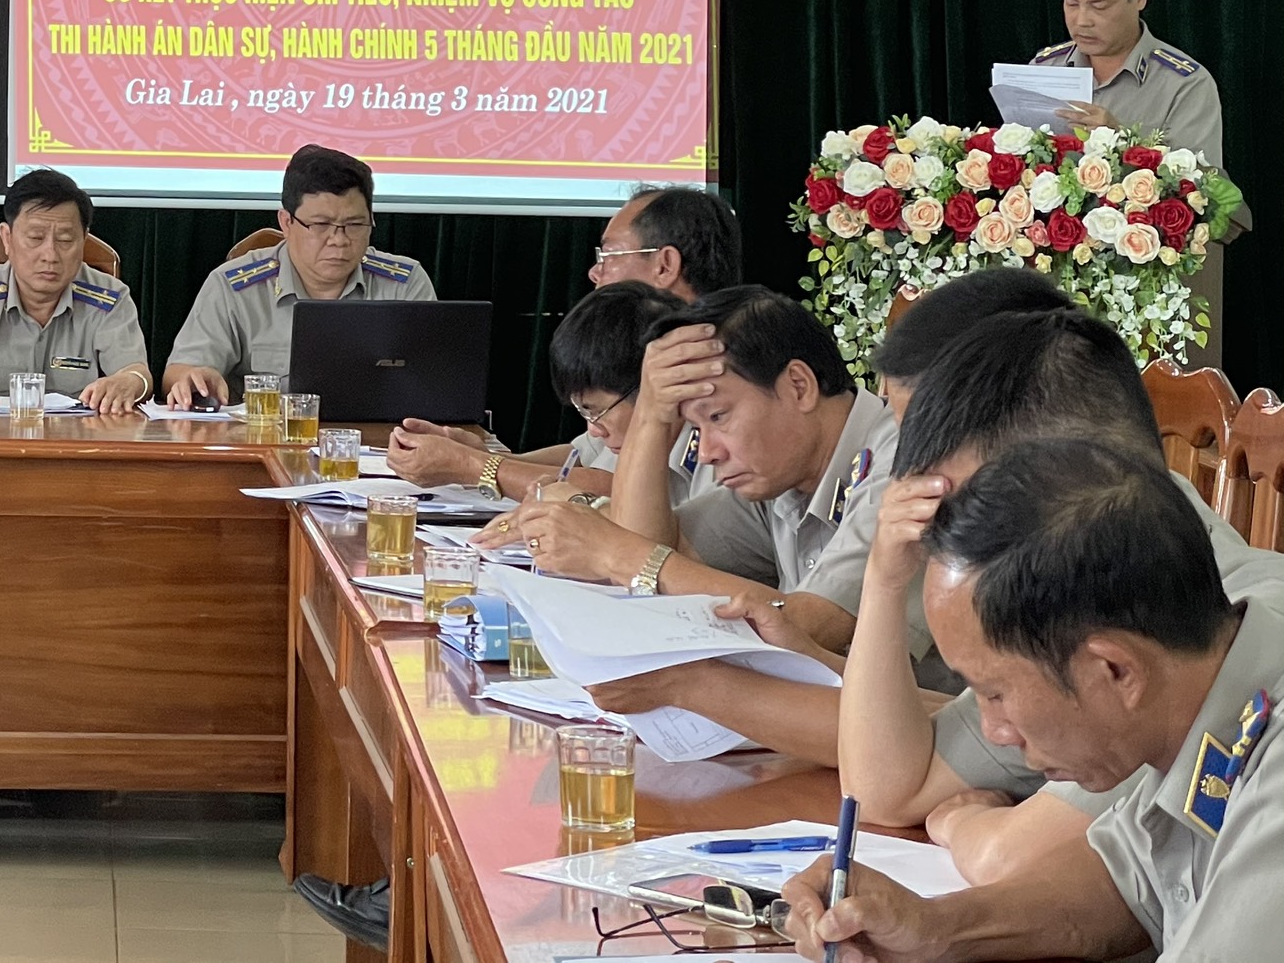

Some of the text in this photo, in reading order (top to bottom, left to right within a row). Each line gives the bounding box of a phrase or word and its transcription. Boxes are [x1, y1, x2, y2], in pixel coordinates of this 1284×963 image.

[48, 19, 693, 65] THI HÀNH ÁN DÂN SỰ, HÀNH CHÍNH 5 THÁNG ĐẦU NĂM 2021
[125, 78, 171, 105] Gia
[179, 79, 226, 106] Lai
[246, 82, 316, 113] ngày
[322, 83, 355, 109] 19
[361, 83, 445, 117] tháng
[451, 85, 468, 111] 3
[475, 87, 538, 112] năm
[544, 87, 608, 114] 2021
[376, 359, 405, 367] ASUS
